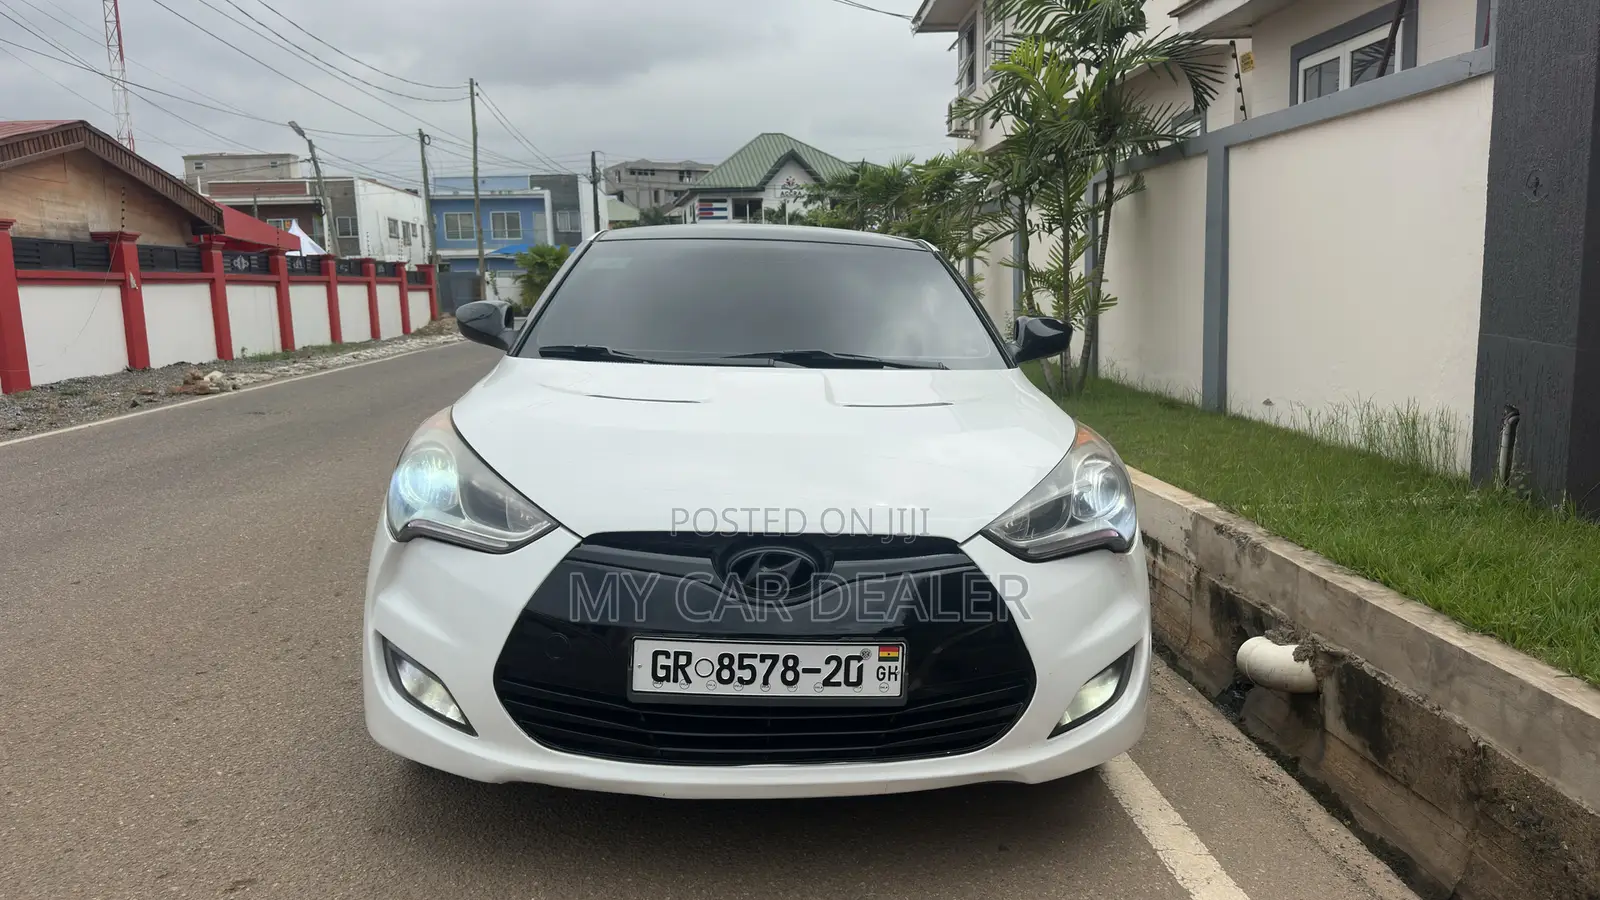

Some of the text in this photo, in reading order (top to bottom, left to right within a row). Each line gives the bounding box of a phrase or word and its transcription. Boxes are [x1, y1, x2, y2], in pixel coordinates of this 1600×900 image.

[651, 649, 864, 687] GR 8578-20
[876, 665, 898, 682] GH
